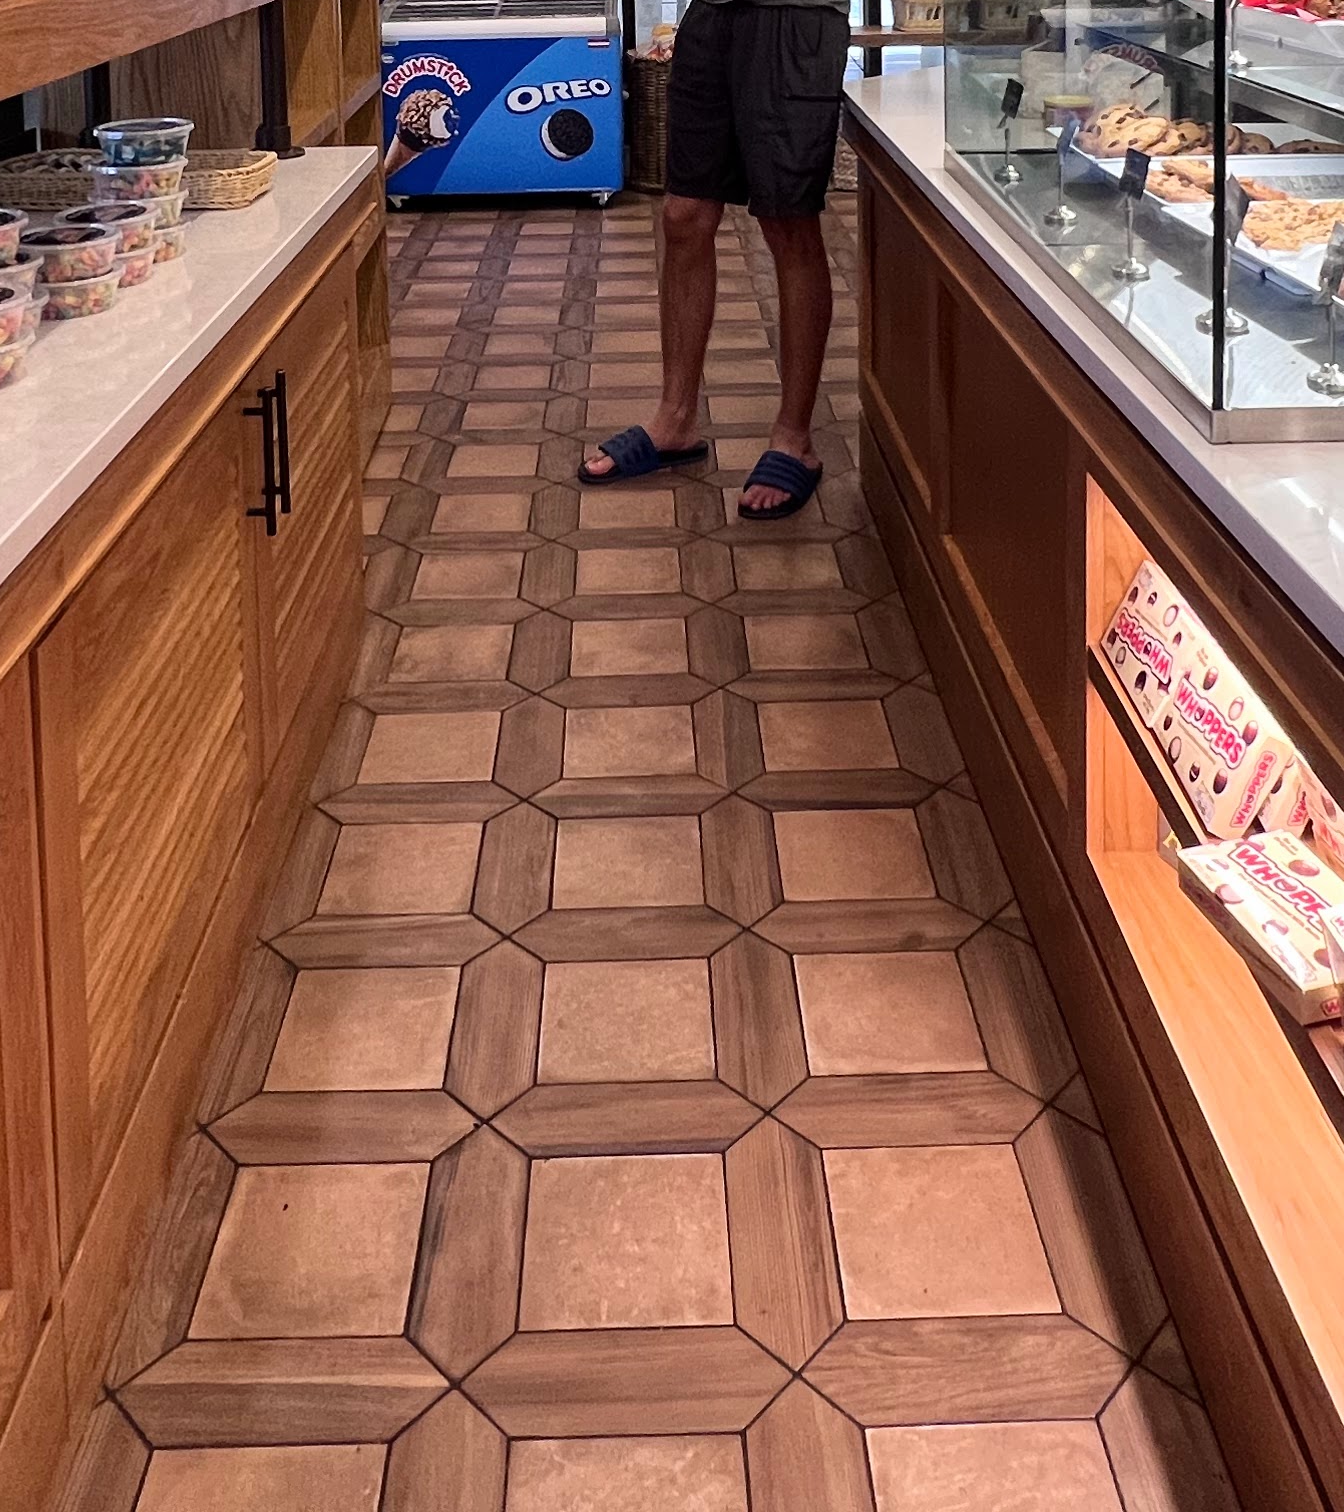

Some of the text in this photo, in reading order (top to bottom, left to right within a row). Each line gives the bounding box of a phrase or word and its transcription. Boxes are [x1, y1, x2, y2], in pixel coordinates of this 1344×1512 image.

[506, 77, 612, 115] OREO
[1114, 610, 1173, 682] WHOPPERS
[1175, 680, 1246, 766] WHOPPERS
[1233, 752, 1276, 828] WHOPPERS
